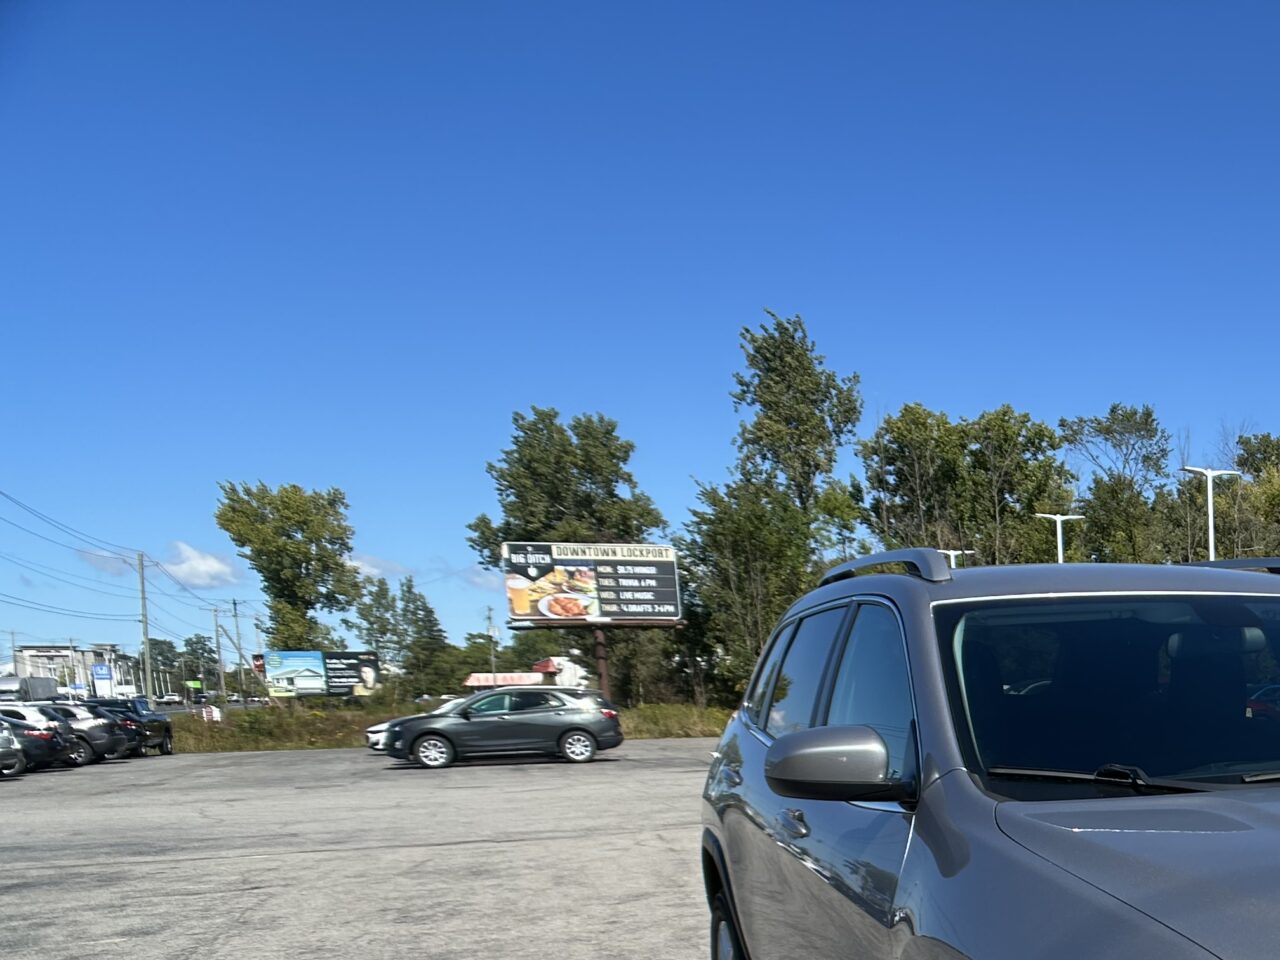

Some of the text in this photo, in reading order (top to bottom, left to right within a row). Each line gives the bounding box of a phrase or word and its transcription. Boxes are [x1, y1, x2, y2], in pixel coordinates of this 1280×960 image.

[556, 546, 670, 559] DOWNTOWN LOCKPORT
[511, 553, 551, 563] BIG DITCH
[618, 578, 640, 587] TRIVIA
[620, 591, 633, 599] LIVE
[634, 591, 655, 599] MUSIC
